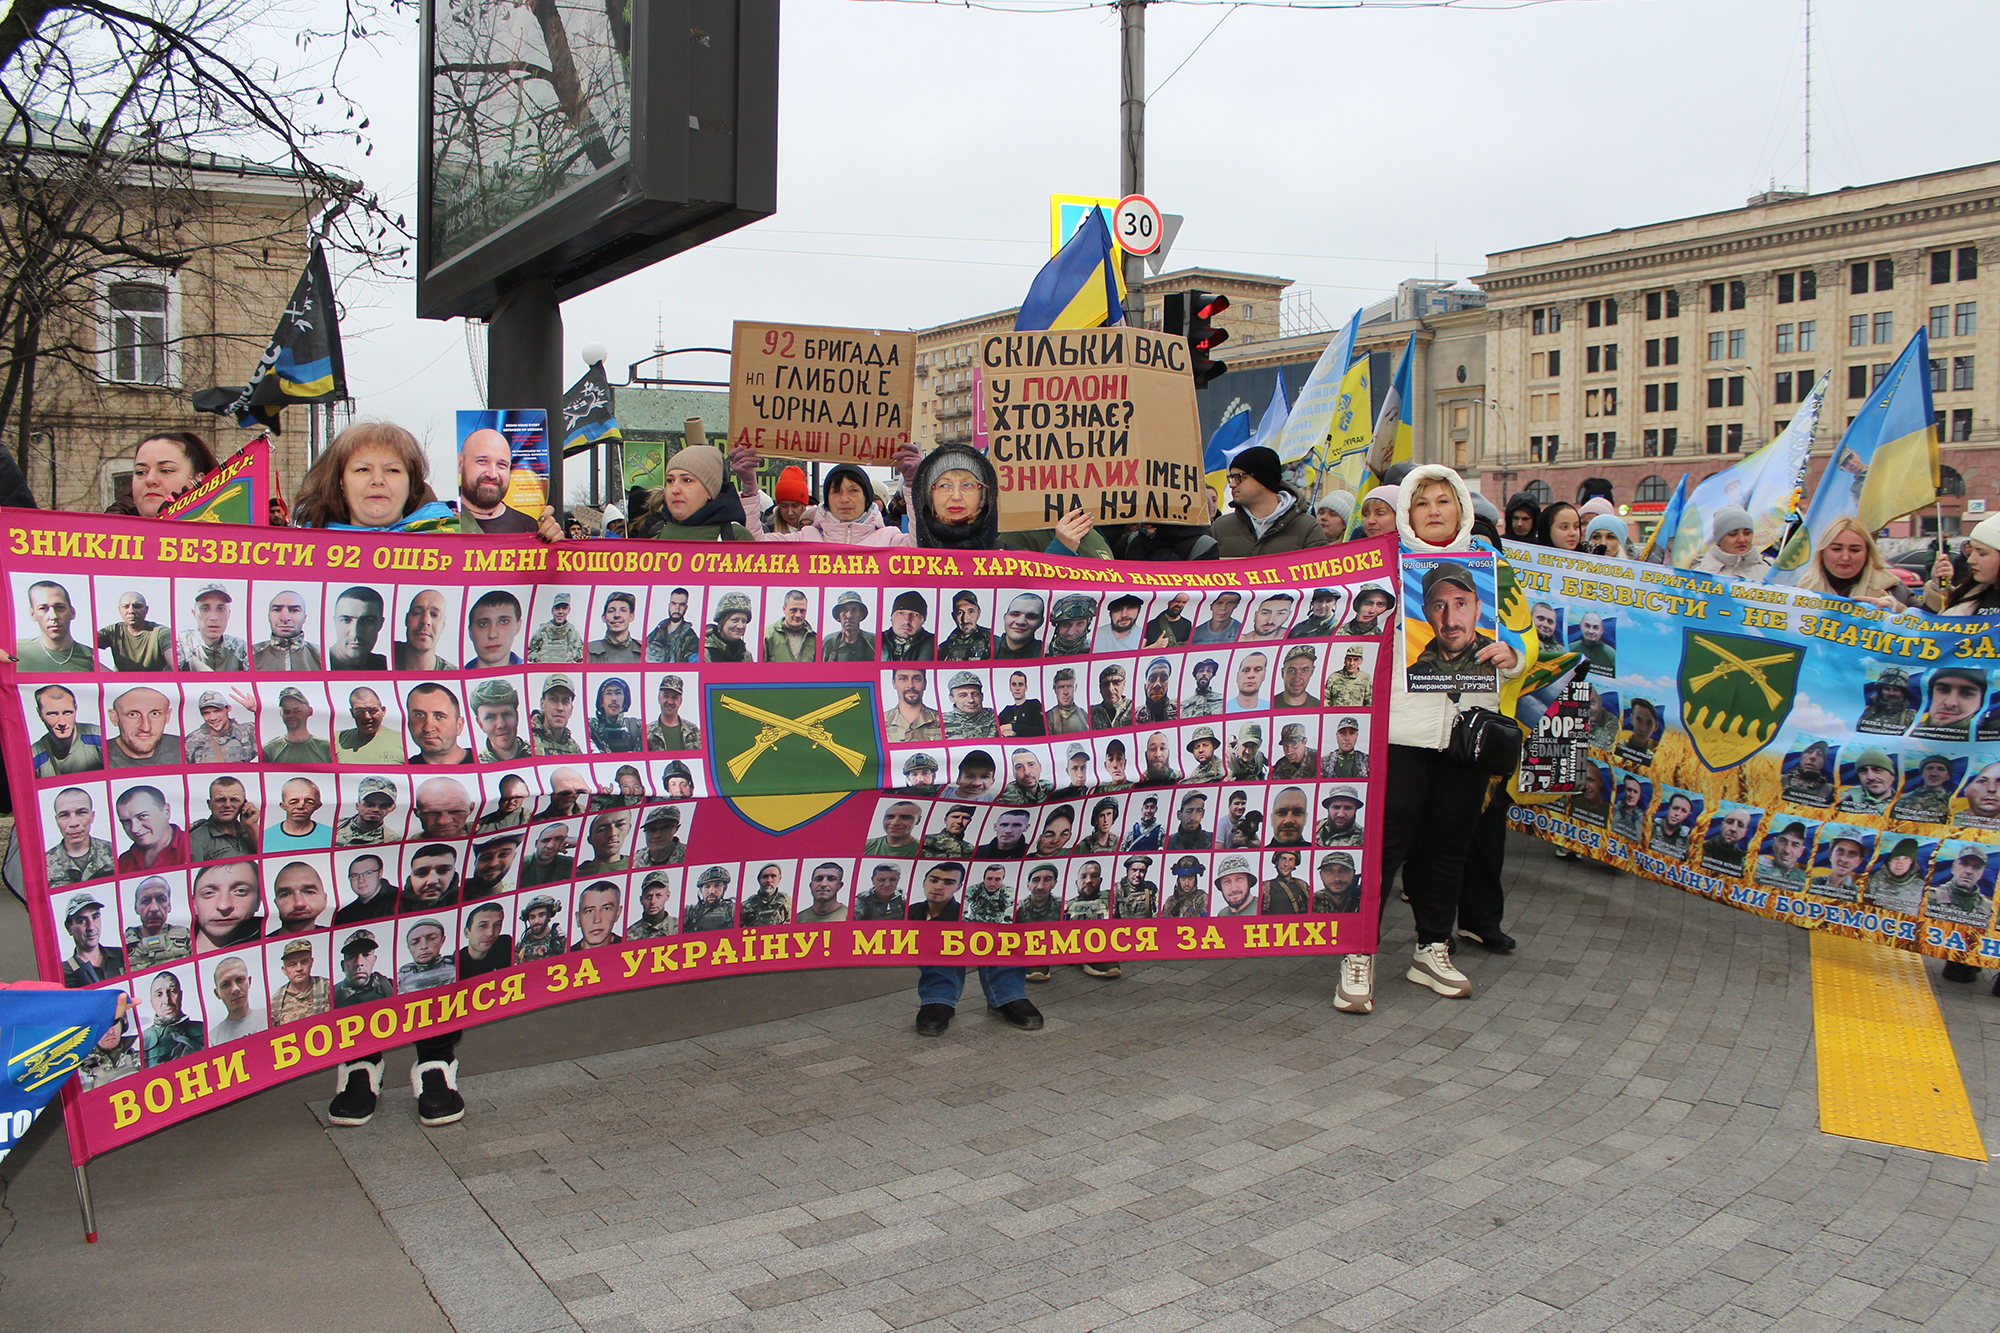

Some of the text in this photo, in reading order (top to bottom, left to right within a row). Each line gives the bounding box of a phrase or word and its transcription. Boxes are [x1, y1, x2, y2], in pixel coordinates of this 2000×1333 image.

[1124, 212, 1153, 238] 30
[762, 330, 899, 368] 92 БРИГАДА
[984, 333, 1185, 371] СКІЛЬКИ ВАС
[775, 365, 891, 396] ГЛИБОКЕ
[992, 374, 1128, 403] У ПОЛОНІ
[752, 394, 901, 429] ЧОРНА ДІРА
[734, 427, 766, 448] ДЕ
[775, 429, 829, 453] НАШІ
[994, 430, 1129, 462] СКІЛЬКИ
[998, 458, 1198, 493] ЗНИКЛИХ ІМЕН
[1044, 493, 1084, 522] НА
[9, 528, 1384, 588] ЗНИКЛІ БЕЗВІСТИ 92 ОШБр ІМЕНІ КОШОВОГО ОТАМАНА ІВАНА СІРКА. ХАРКІВСЬКИЙ НАПРЯМОК Н.П. ГЛИБОКЕ
[1538, 553, 1634, 580] ШТУРМОВА
[1640, 570, 1724, 595] БРИГАДА
[1730, 586, 1788, 605] ІМЕНІ
[1560, 576, 1708, 619] БЕЗВІСТИ
[1741, 607, 1788, 630] НЕ
[1799, 615, 1941, 660] ЗНАЧИТЬ
[1954, 636, 2000, 659] ЗА
[1409, 674, 1495, 682] Ткемаладзе Олександр
[1411, 683, 1456, 691] Амиранович
[1539, 715, 1574, 738] POP
[1539, 744, 1570, 757] DANCE
[1606, 839, 1630, 861] ЗА
[1634, 849, 1724, 896] УКРАЇНУ!
[1731, 885, 1768, 909] МИ
[1775, 897, 1916, 940] БОРЕМОСЯ
[1926, 926, 1968, 951] ЗА
[109, 920, 1339, 1130] ВОНИ БОРОЛИСЯ ЗА УКРАЇНУ! МИ БОРЕМОСЯ ЗА НИХ!
